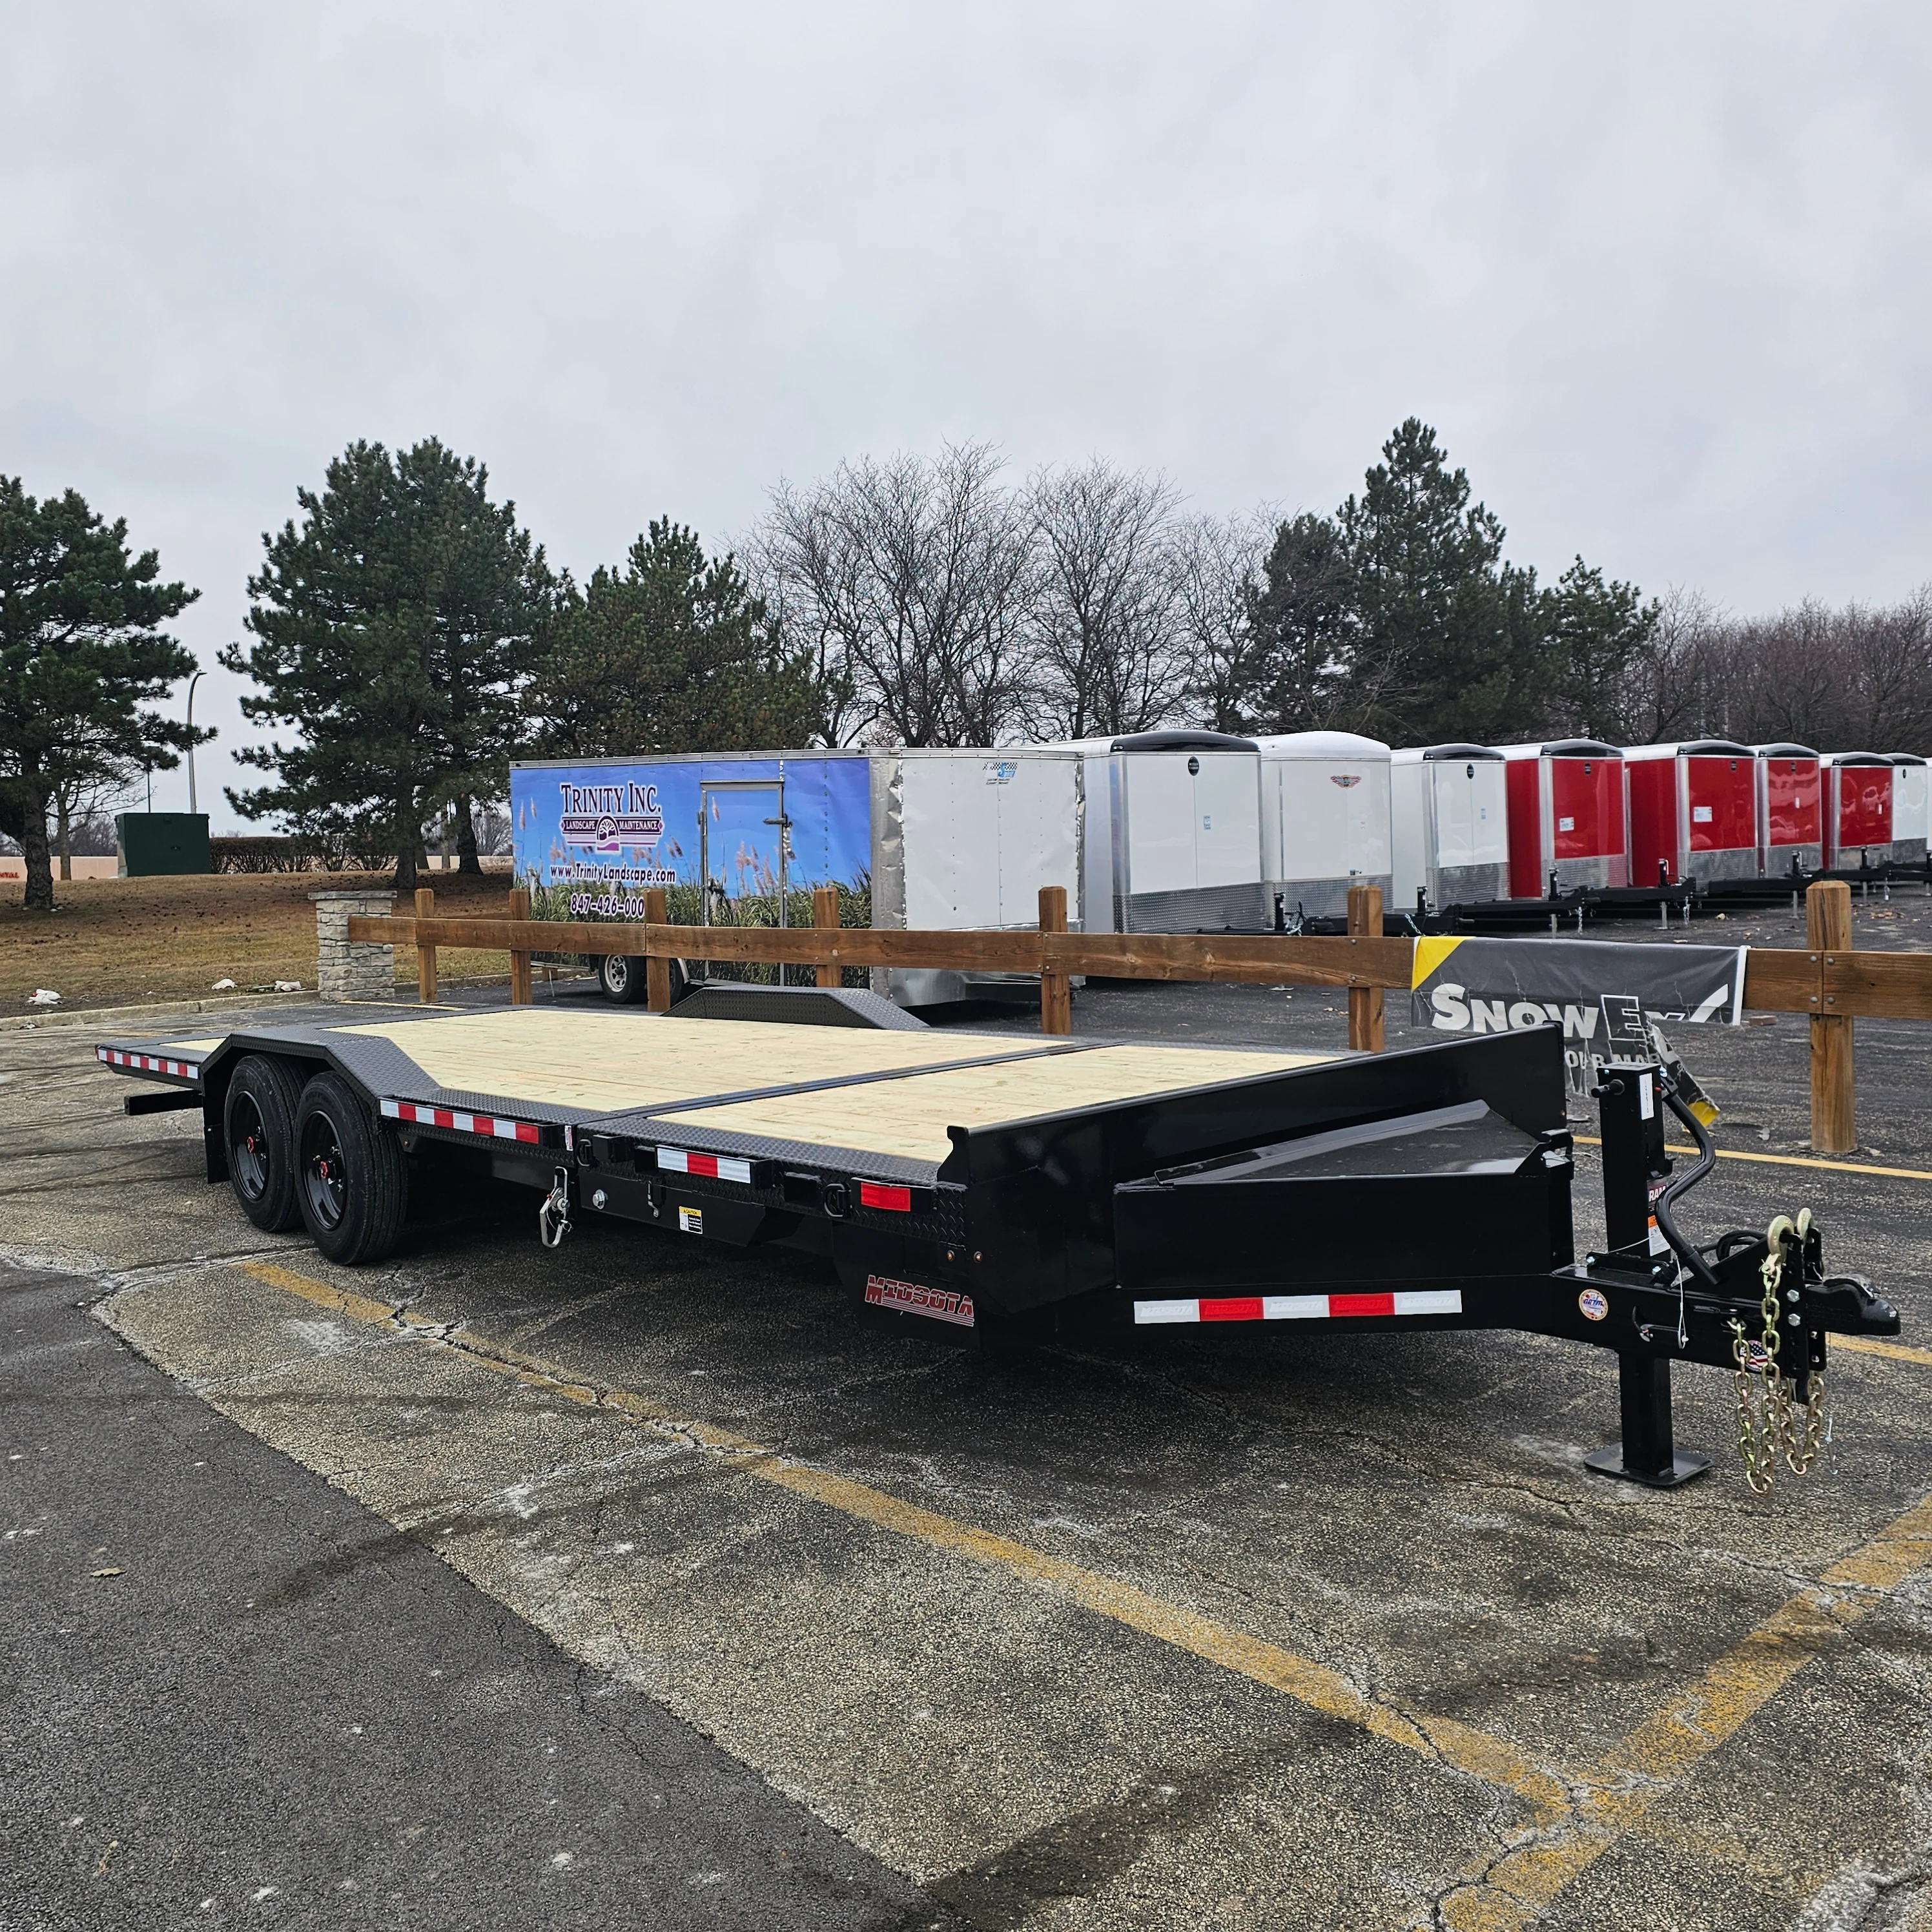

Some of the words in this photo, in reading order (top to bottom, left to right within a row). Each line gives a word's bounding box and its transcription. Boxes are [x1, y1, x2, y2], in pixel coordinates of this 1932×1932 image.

[561, 784, 624, 813] TRINITY
[628, 783, 661, 814] INC.
[566, 820, 595, 830] LANDSCAPE
[619, 820, 658, 831] MAINTENANCE
[550, 863, 675, 885] www.TrinityLandscape.com
[571, 894, 644, 918] 847-426-000
[865, 1274, 974, 1318] MIDSOTA
